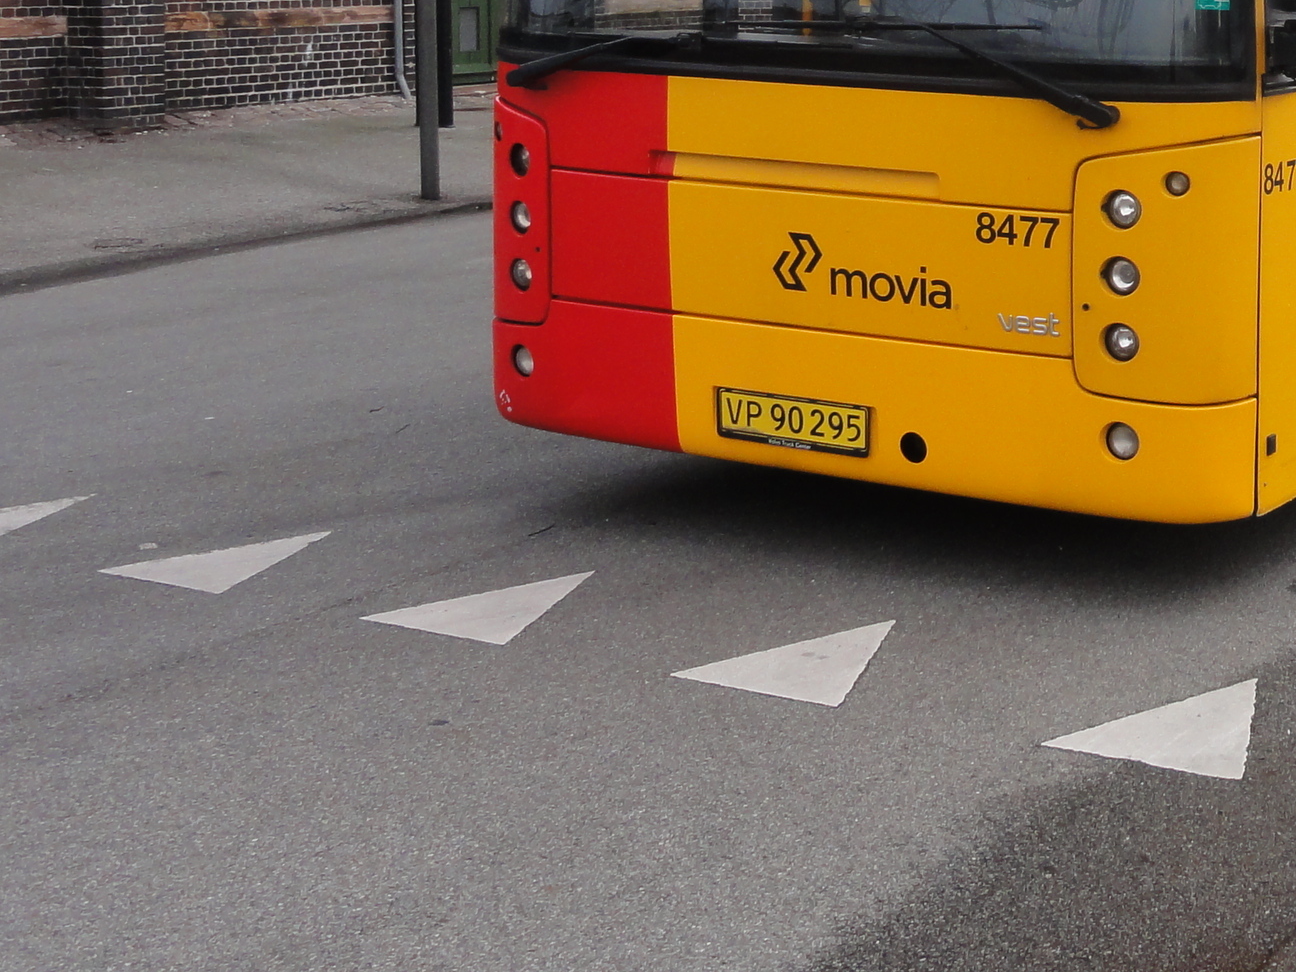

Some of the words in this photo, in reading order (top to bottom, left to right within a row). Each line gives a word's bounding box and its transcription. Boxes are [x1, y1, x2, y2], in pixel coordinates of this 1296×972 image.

[975, 212, 1060, 249] 8477
[830, 266, 952, 310] movia
[997, 312, 1060, 337] vest
[725, 397, 762, 428] VP
[770, 403, 804, 434] 90
[809, 409, 862, 443] 295
